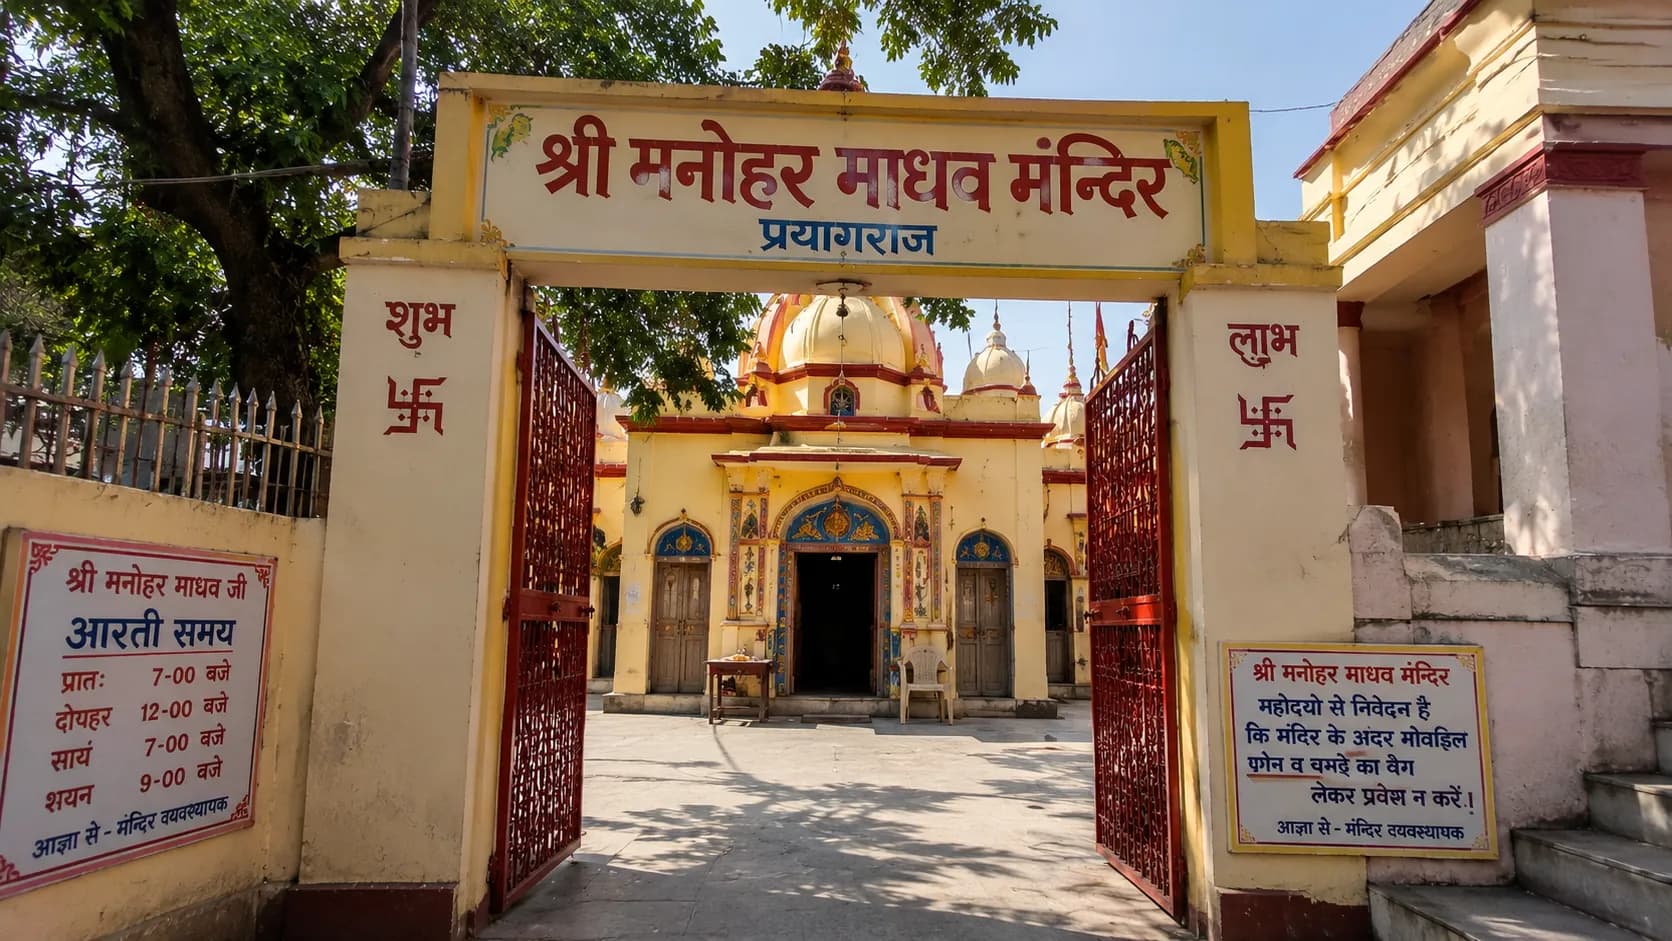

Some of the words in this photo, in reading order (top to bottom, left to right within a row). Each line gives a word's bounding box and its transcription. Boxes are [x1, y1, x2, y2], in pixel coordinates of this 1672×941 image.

[536, 115, 616, 198] श्री
[629, 119, 820, 210] मनोहर
[834, 147, 996, 213] माधव
[758, 219, 937, 257] प्रयागराज
[385, 301, 456, 349] शुभ
[66, 560, 98, 593] श्री
[105, 564, 168, 598] मनोहर
[175, 576, 222, 598] माधव
[227, 573, 247, 600] जी
[65, 608, 164, 649] आरती
[174, 619, 236, 648] समय
[153, 666, 195, 686] 7-00
[206, 659, 231, 682] बजे
[1253, 657, 1276, 681] श्री
[1281, 658, 1339, 685] मनोहर
[1344, 666, 1395, 684] माधव
[141, 700, 192, 721] 12-00
[203, 691, 229, 714] बजे
[1258, 693, 1324, 717] महोदयो
[1328, 694, 1346, 716] से
[1350, 694, 1412, 719] निवेदन
[1416, 695, 1431, 721] है
[51, 740, 93, 772] सायं
[145, 733, 188, 757] 7-00
[200, 723, 226, 747] बजे
[1245, 722, 1270, 744] कि
[1276, 722, 1322, 746] मंदिर
[1326, 723, 1346, 745] के
[1353, 726, 1394, 748] अंदर
[1356, 756, 1381, 775] का
[45, 785, 95, 813] शयन
[140, 768, 185, 793] 9-00
[197, 755, 223, 780] बजे
[1311, 781, 1355, 805] लेकर
[1411, 790, 1427, 806] न
[85, 821, 101, 845] से
[1317, 817, 1334, 835] से
